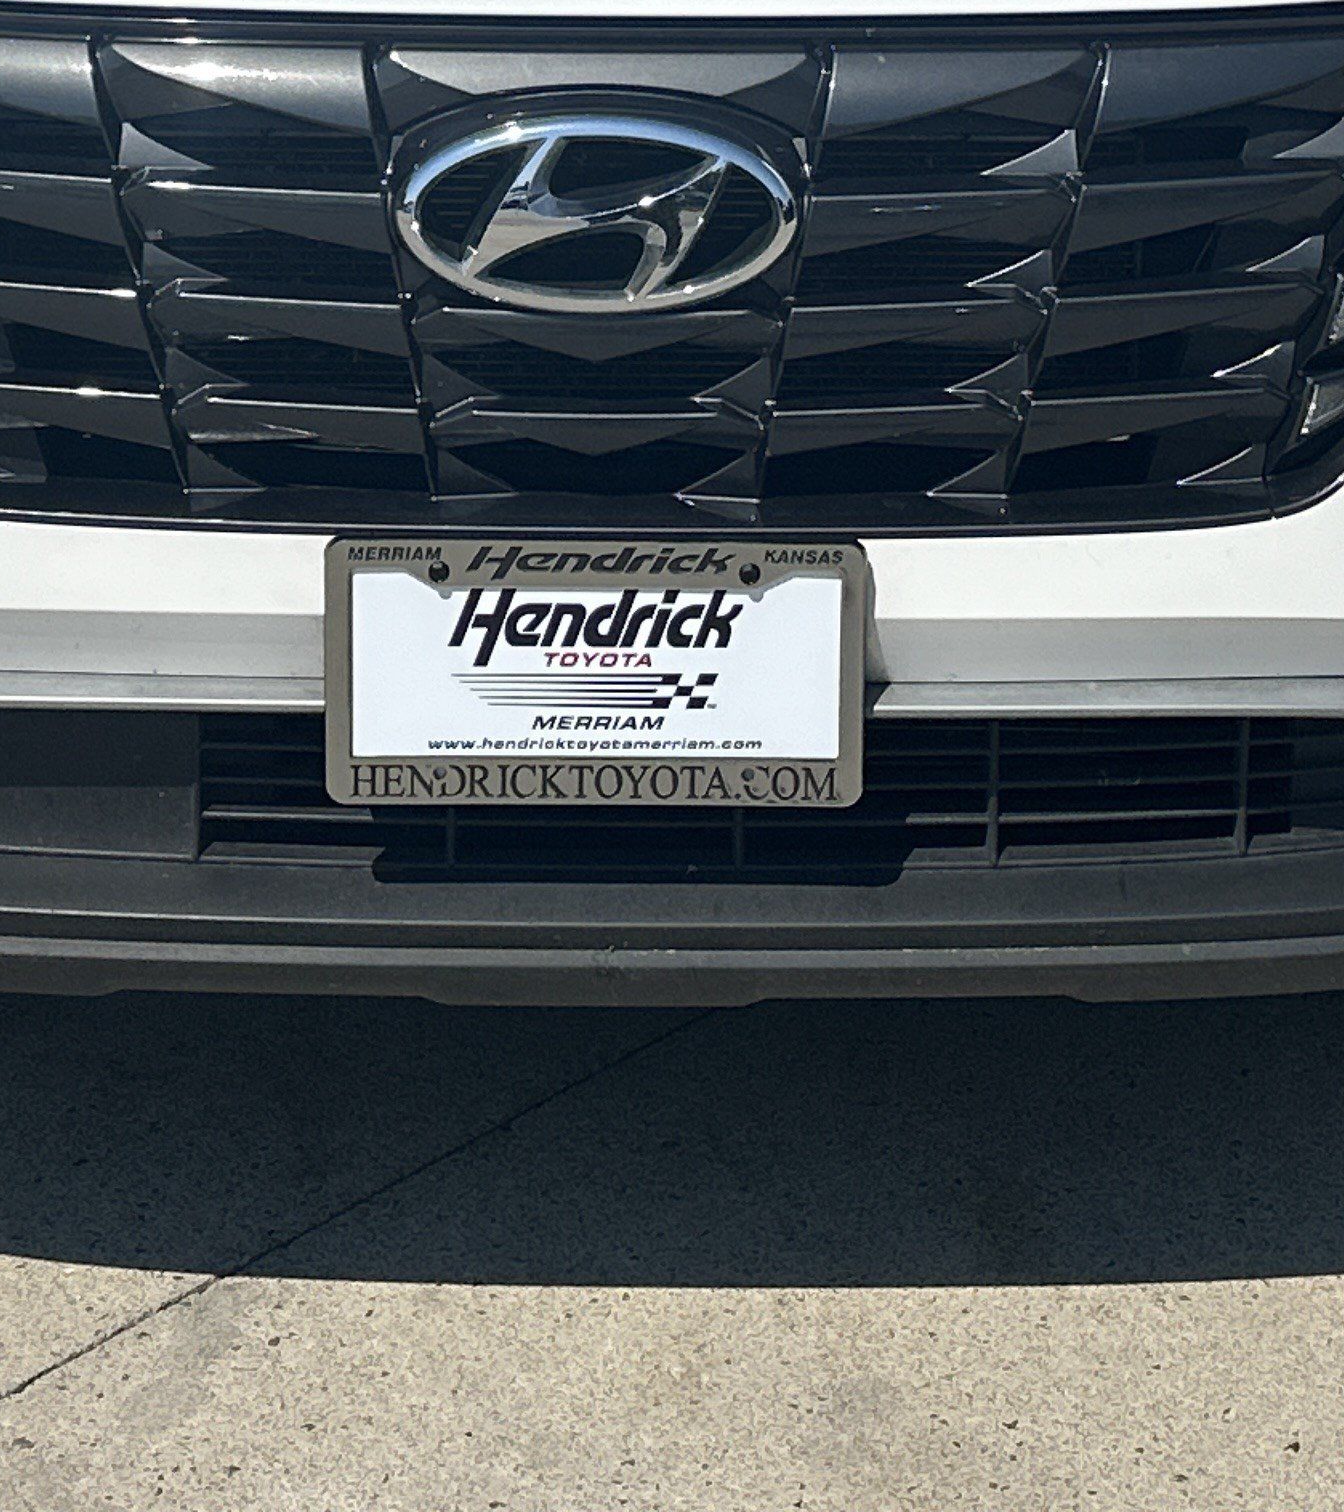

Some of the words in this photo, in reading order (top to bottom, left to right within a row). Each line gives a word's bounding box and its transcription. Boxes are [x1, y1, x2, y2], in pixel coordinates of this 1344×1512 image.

[348, 546, 443, 561] MERRIAM
[764, 548, 844, 566] KANSAS
[465, 545, 736, 581] Hendrick
[447, 588, 744, 667] Hendrick
[544, 652, 653, 668] TOYOTA
[531, 715, 665, 731] MERRIAM
[427, 736, 763, 751] www.hendricktoyotamerriam.com
